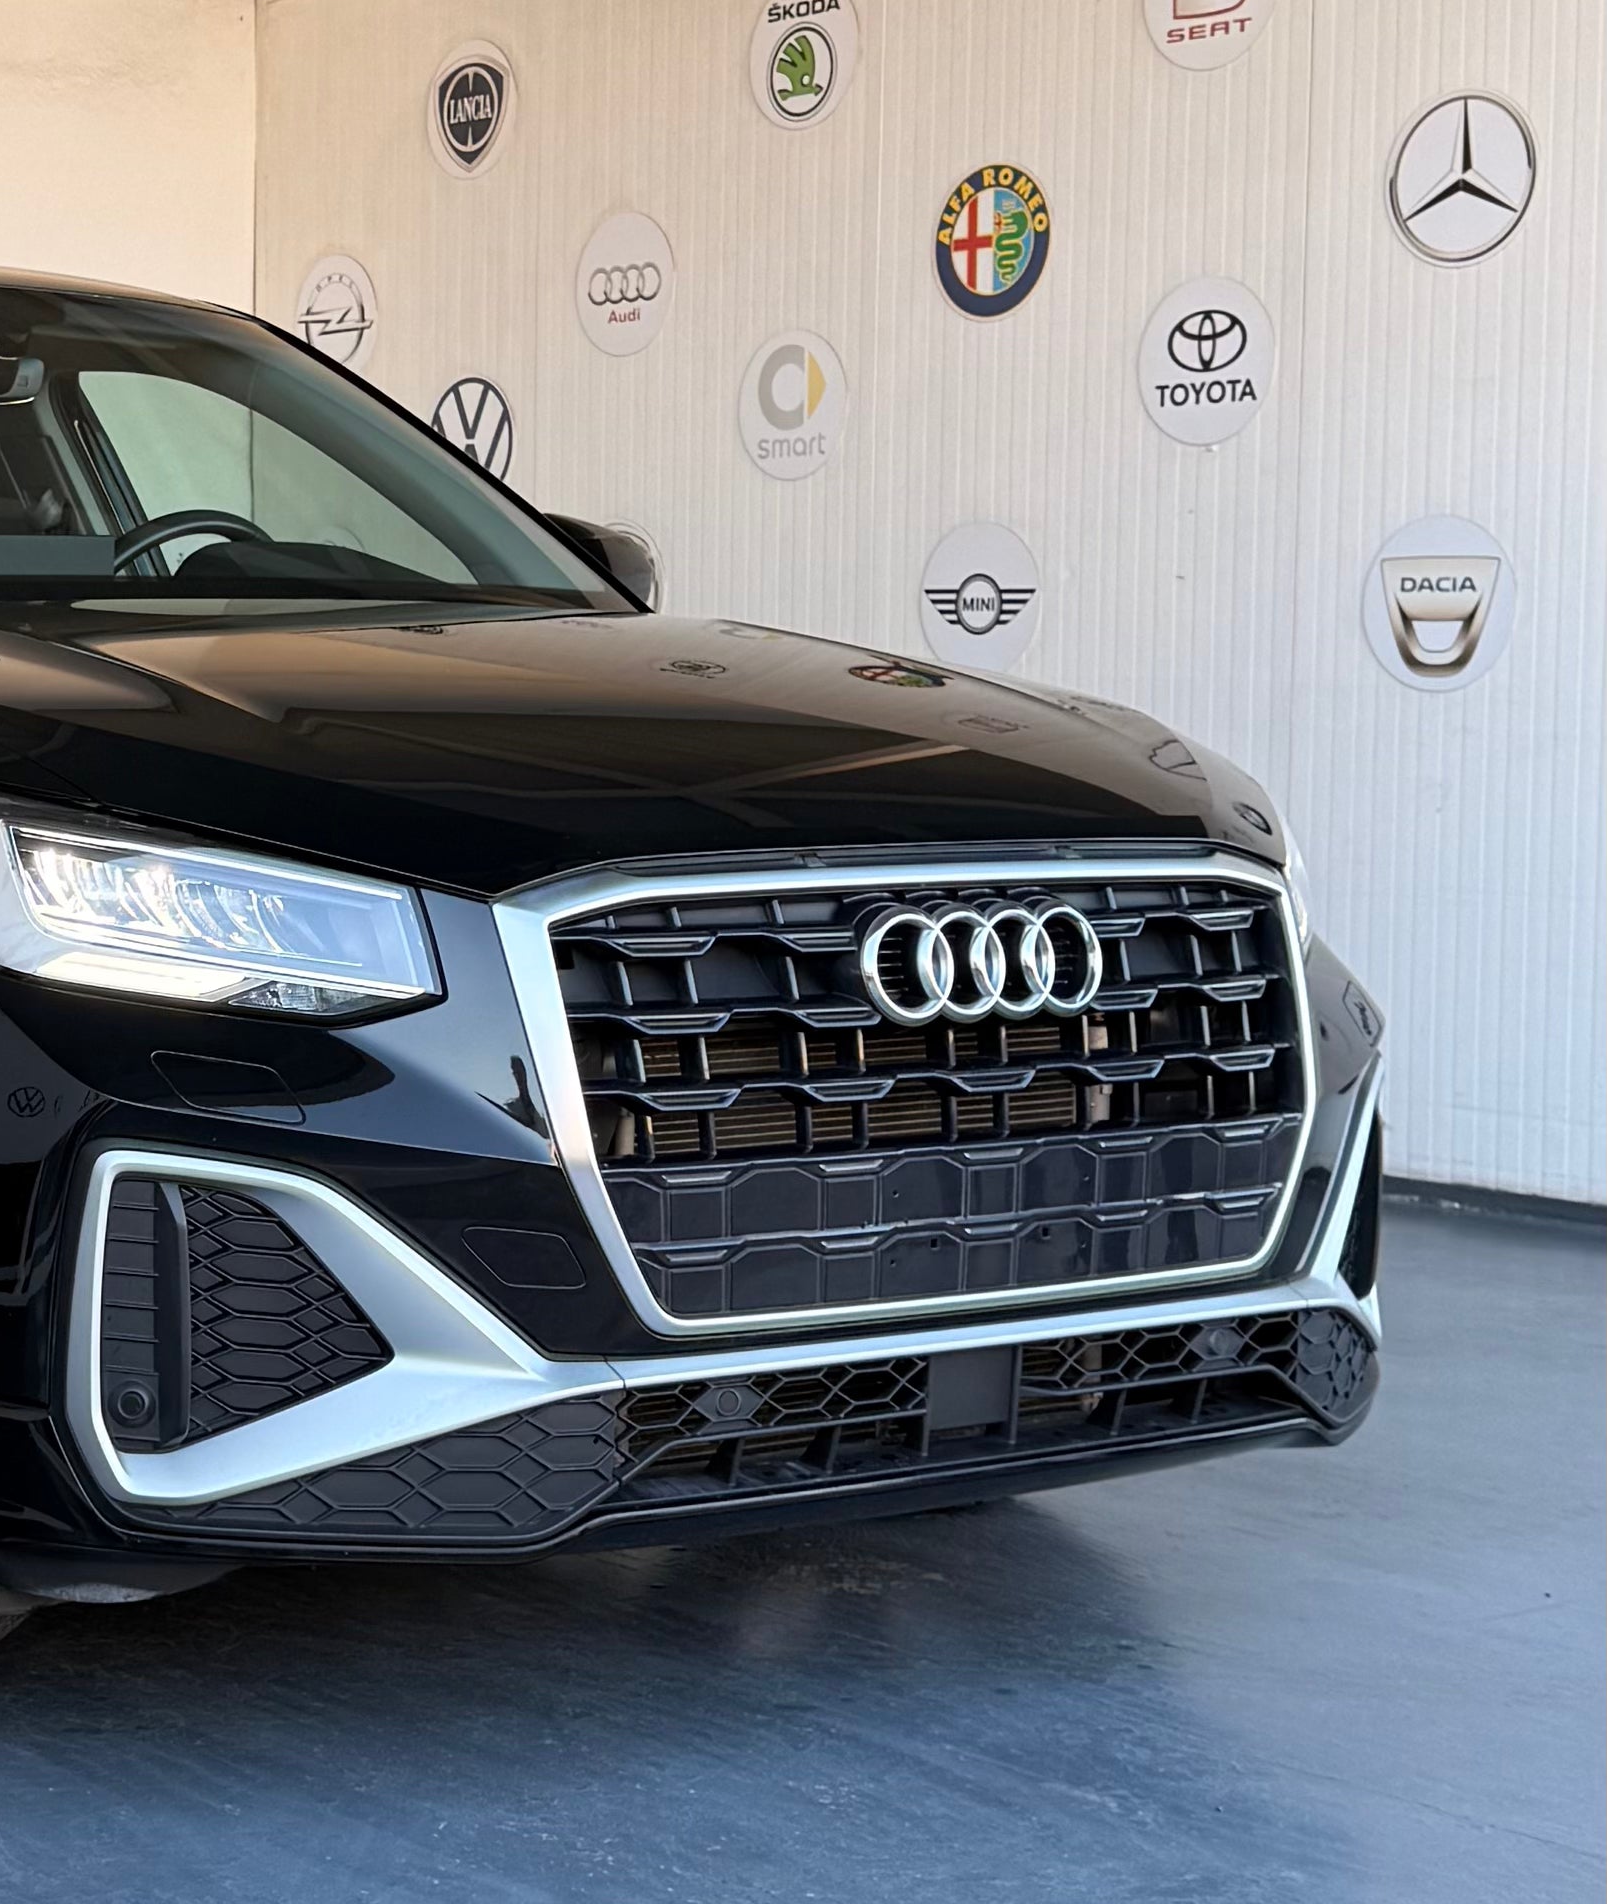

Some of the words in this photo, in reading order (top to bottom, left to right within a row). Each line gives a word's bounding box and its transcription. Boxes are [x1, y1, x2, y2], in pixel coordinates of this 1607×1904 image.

[1166, 17, 1252, 43] SEAT
[450, 94, 492, 124] LANCIA
[938, 182, 976, 246] ALFA
[982, 167, 1048, 233] ROMEO
[608, 307, 641, 324] Audi
[1155, 378, 1257, 407] TOYOTA
[758, 432, 826, 459] smart
[1400, 576, 1477, 592] DACIA
[962, 597, 995, 611] MINI
